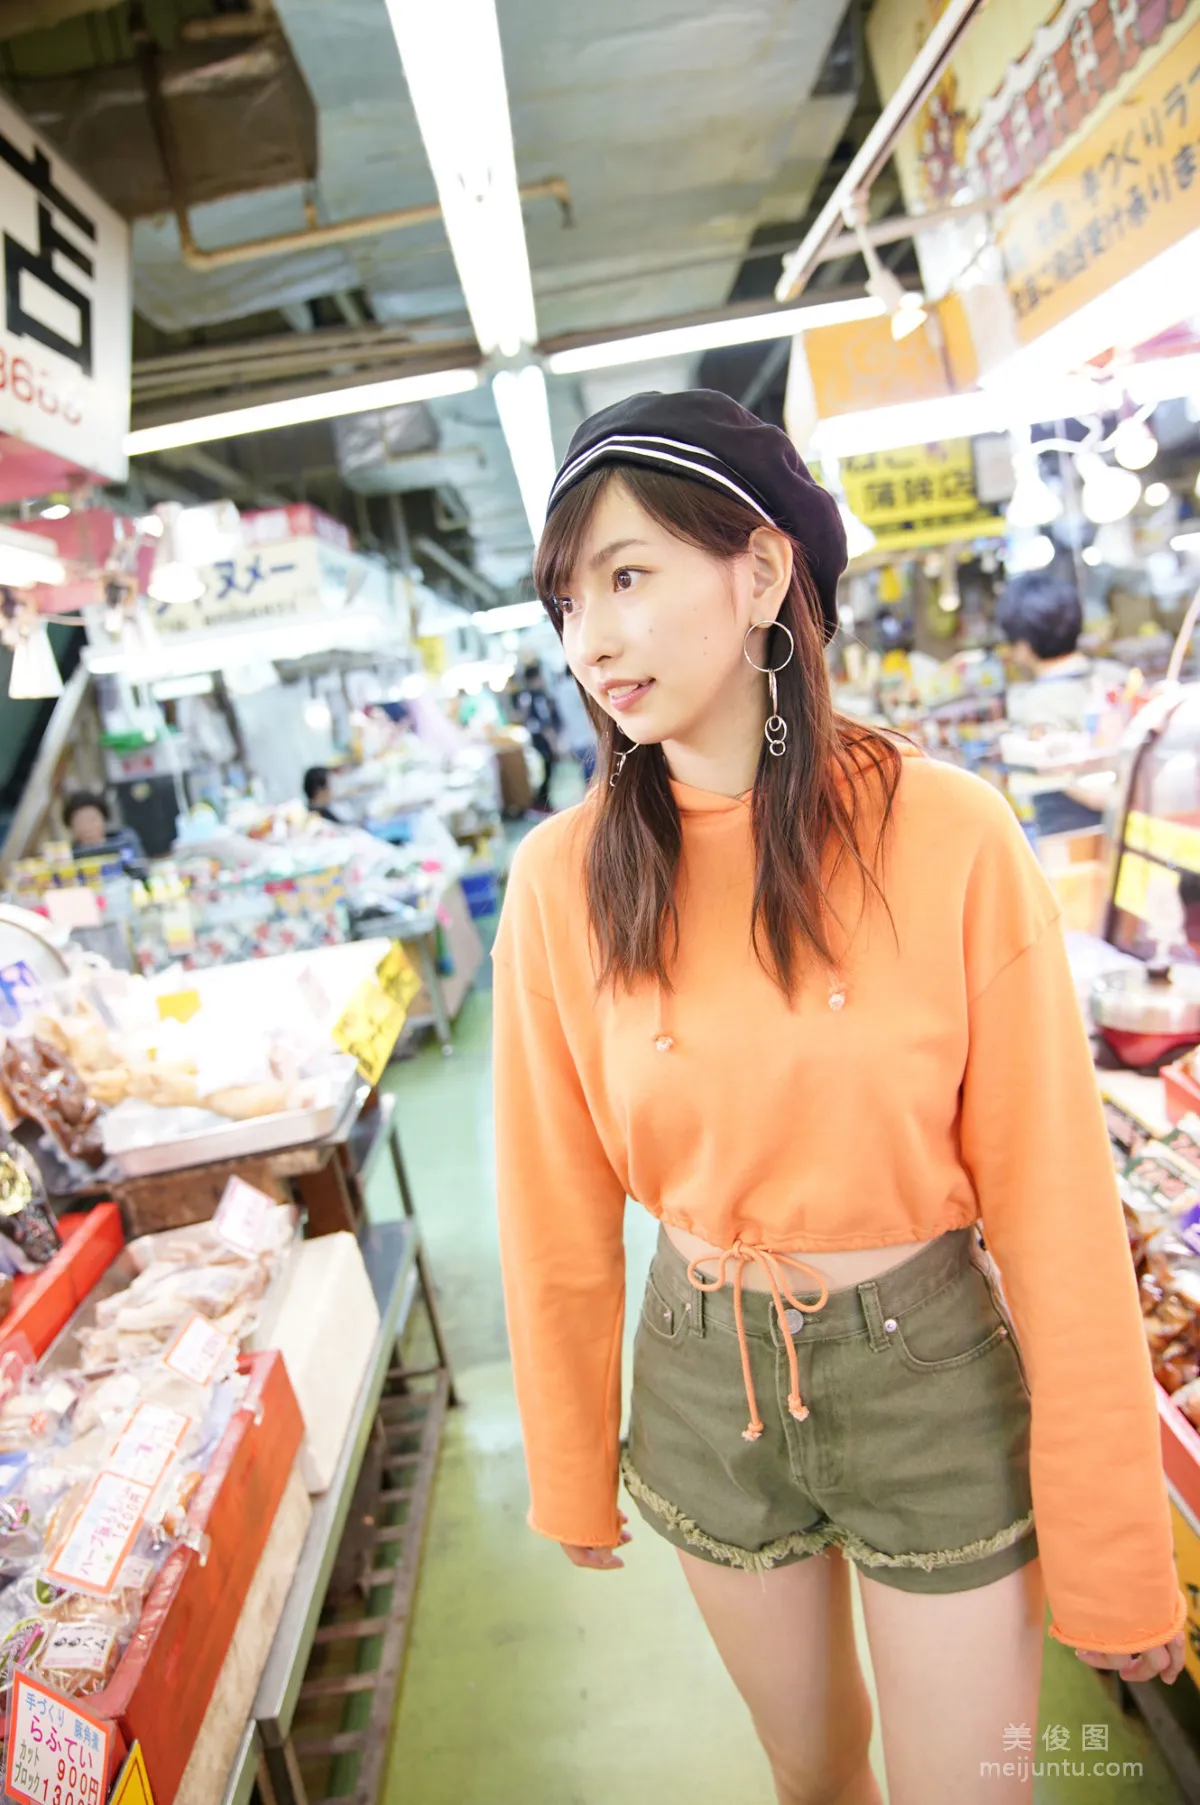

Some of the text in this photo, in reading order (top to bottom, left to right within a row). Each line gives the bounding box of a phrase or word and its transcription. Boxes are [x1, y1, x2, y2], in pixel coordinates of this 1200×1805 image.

[26, 1692, 65, 1728] 手づくり
[14, 1761, 41, 1794] ブロック
[20, 1739, 100, 1805] カット 900円
